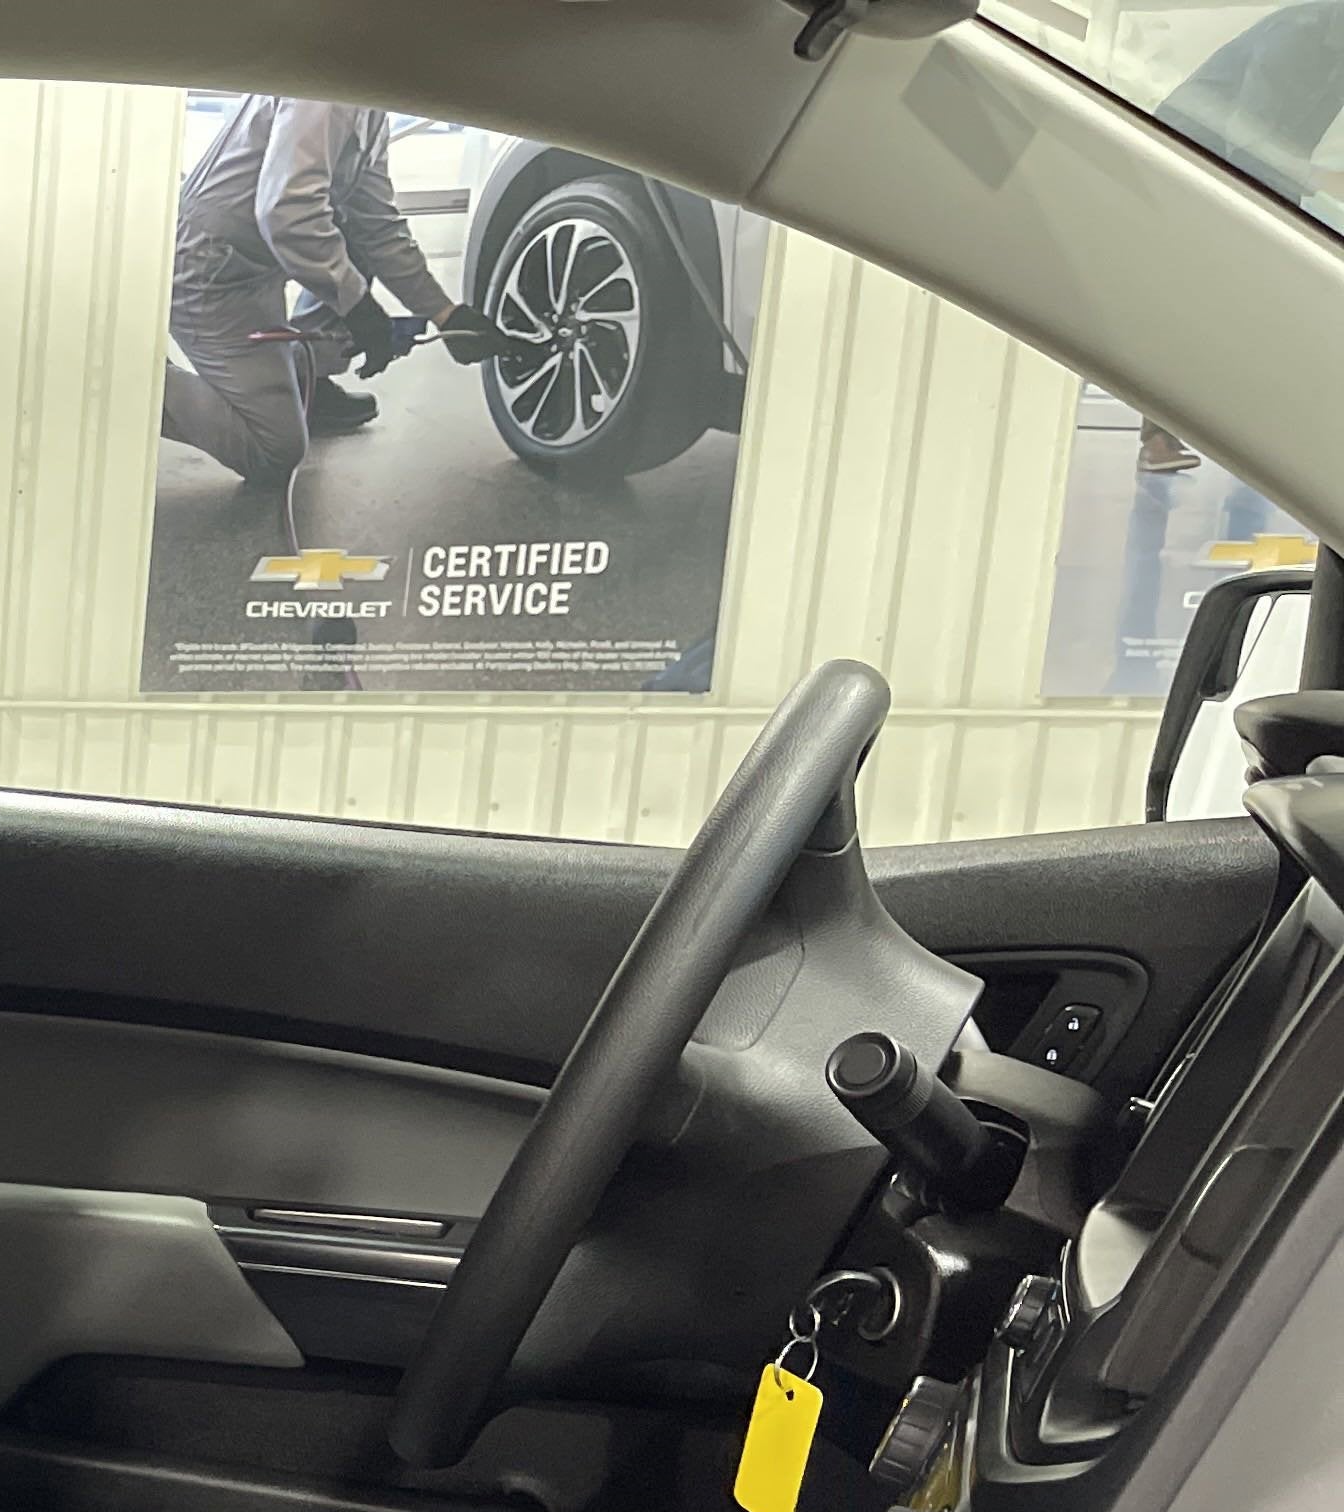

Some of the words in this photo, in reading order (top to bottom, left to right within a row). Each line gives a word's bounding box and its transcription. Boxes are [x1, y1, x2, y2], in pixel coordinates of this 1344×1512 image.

[422, 541, 610, 579] CERTIFIED
[245, 600, 393, 618] CHEVROLET
[417, 581, 573, 617] SERVICE
